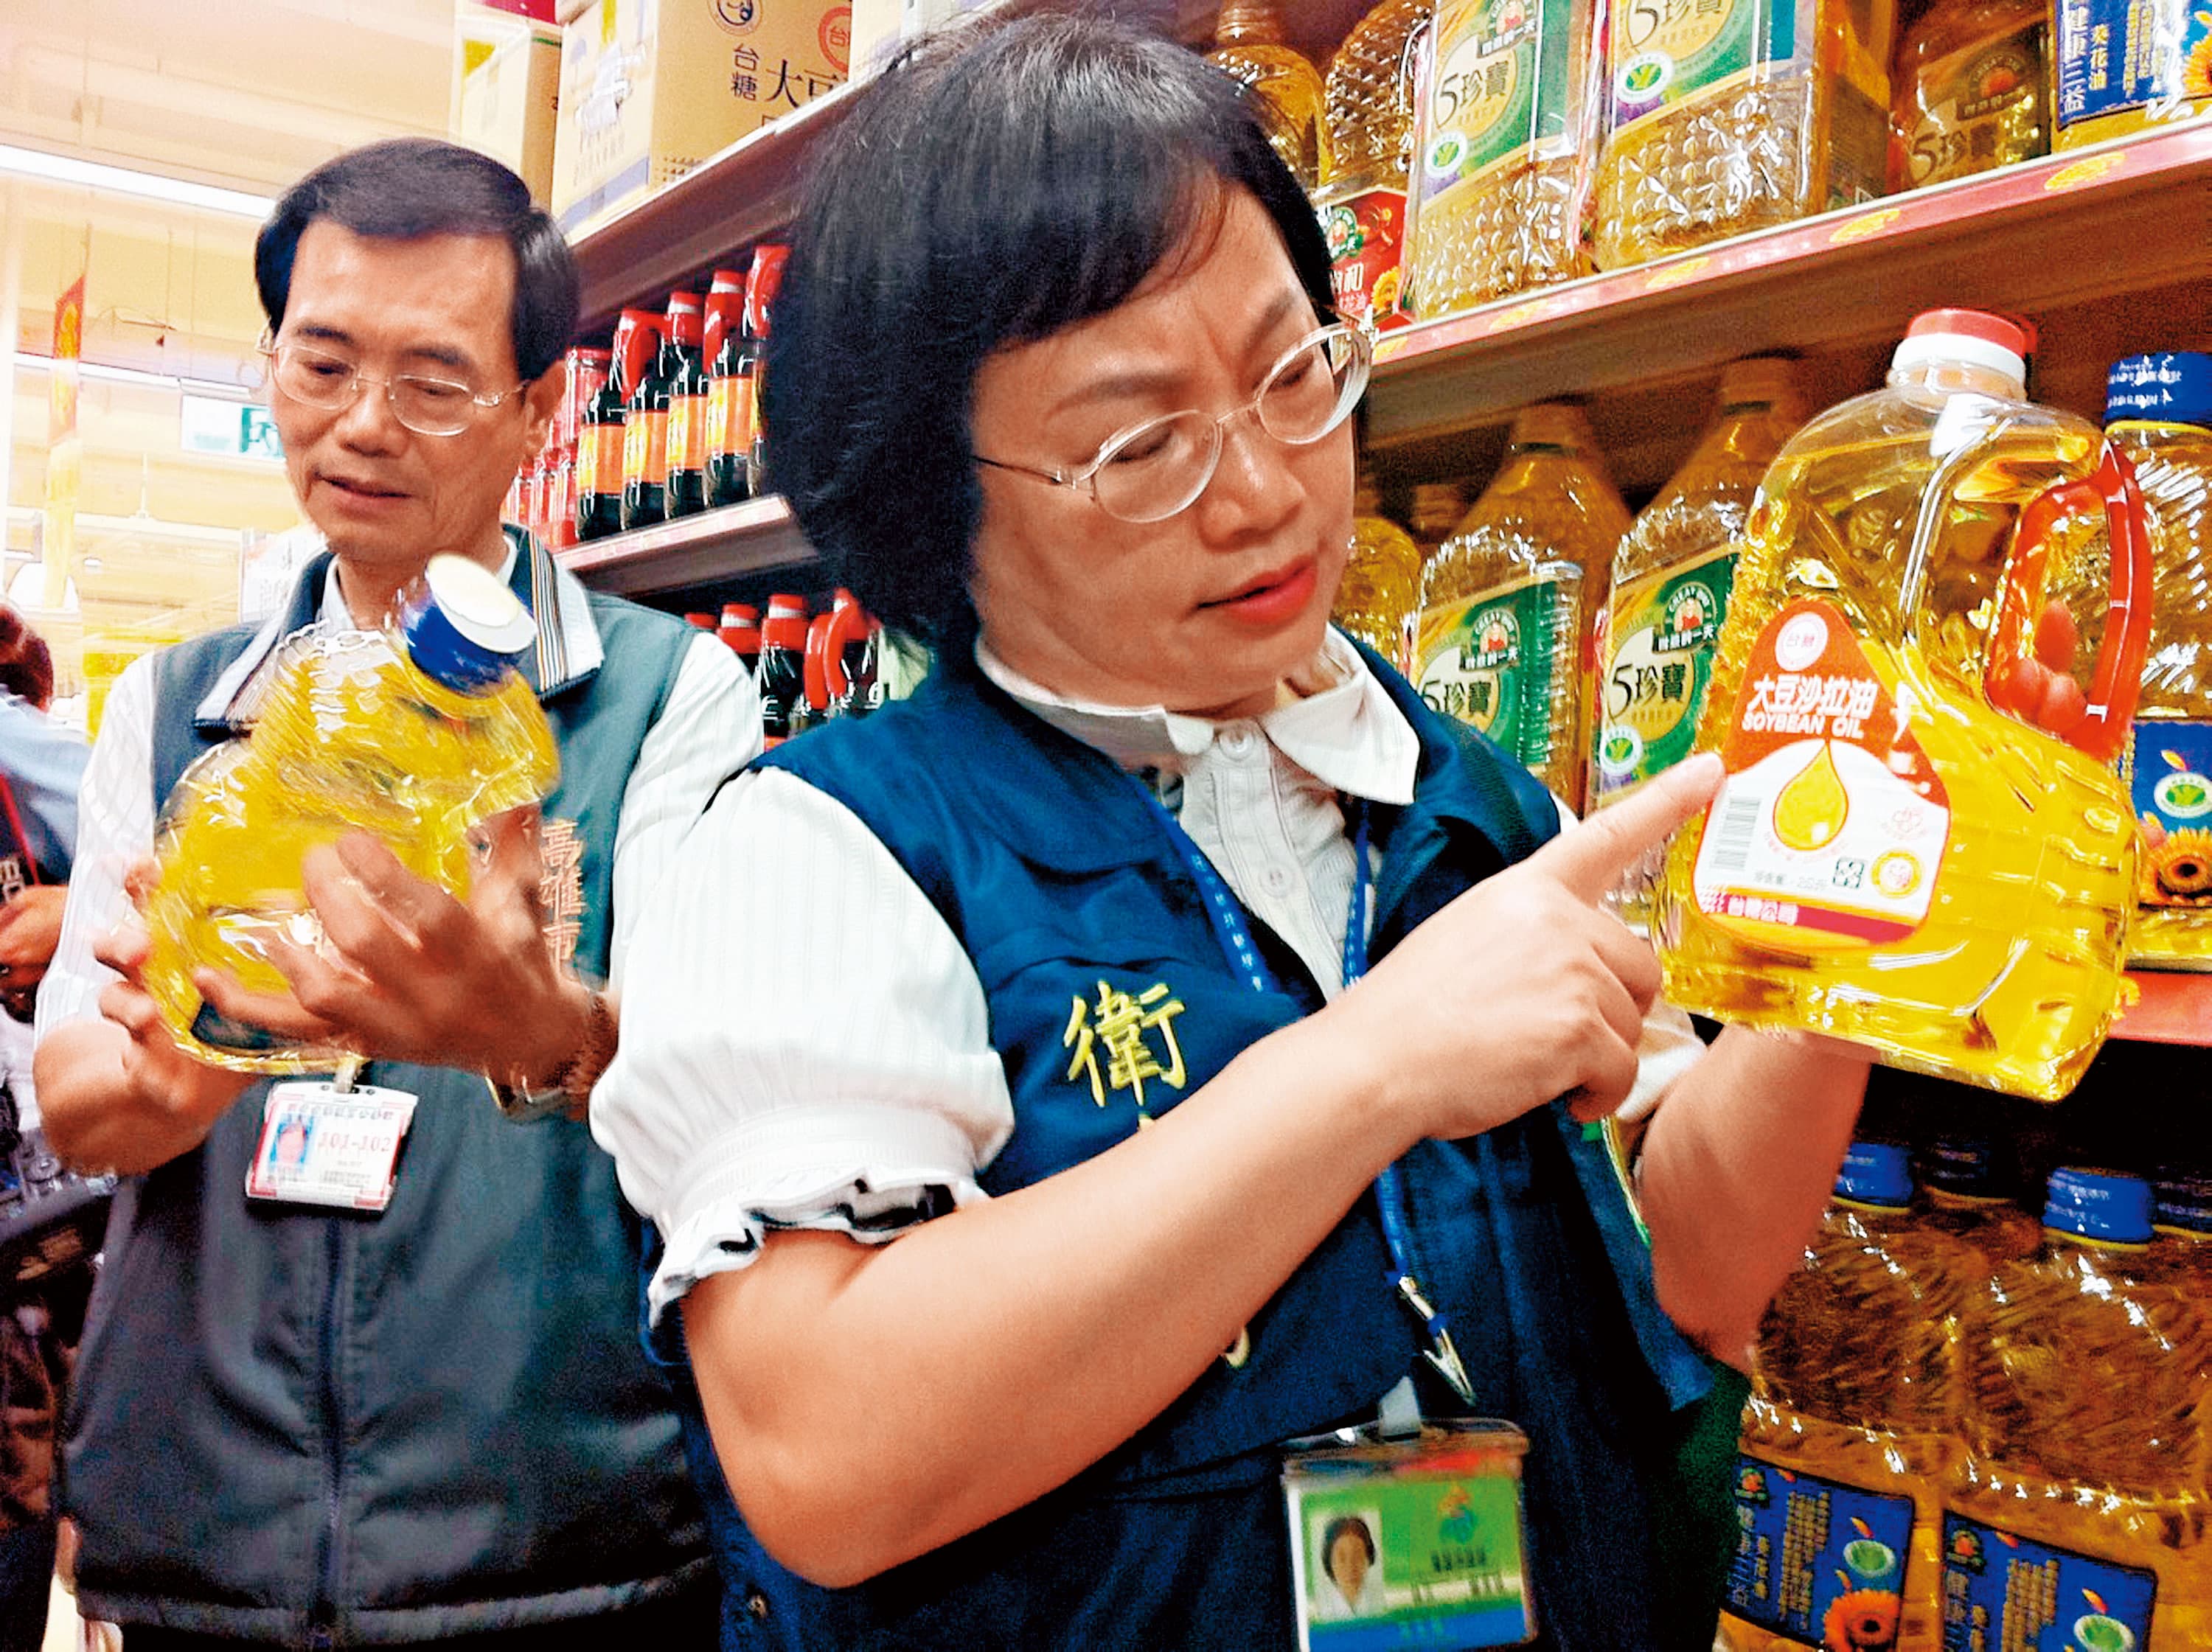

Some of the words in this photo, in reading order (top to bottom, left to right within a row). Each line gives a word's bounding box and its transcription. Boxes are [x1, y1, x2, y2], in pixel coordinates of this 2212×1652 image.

[829, 25, 850, 47] 台
[2089, 24, 2109, 91] 葵花油
[731, 42, 760, 102] 台糖
[1438, 60, 1509, 122] 5珍寶
[1422, 679, 1492, 718] 5珍寶
[1612, 663, 1686, 712] 5珍寶
[1746, 674, 1879, 720] 大豆沙拉油
[1741, 711, 1826, 735] SOYBEAN
[1832, 716, 1865, 739] OIL
[1063, 979, 1187, 1120] 衛
